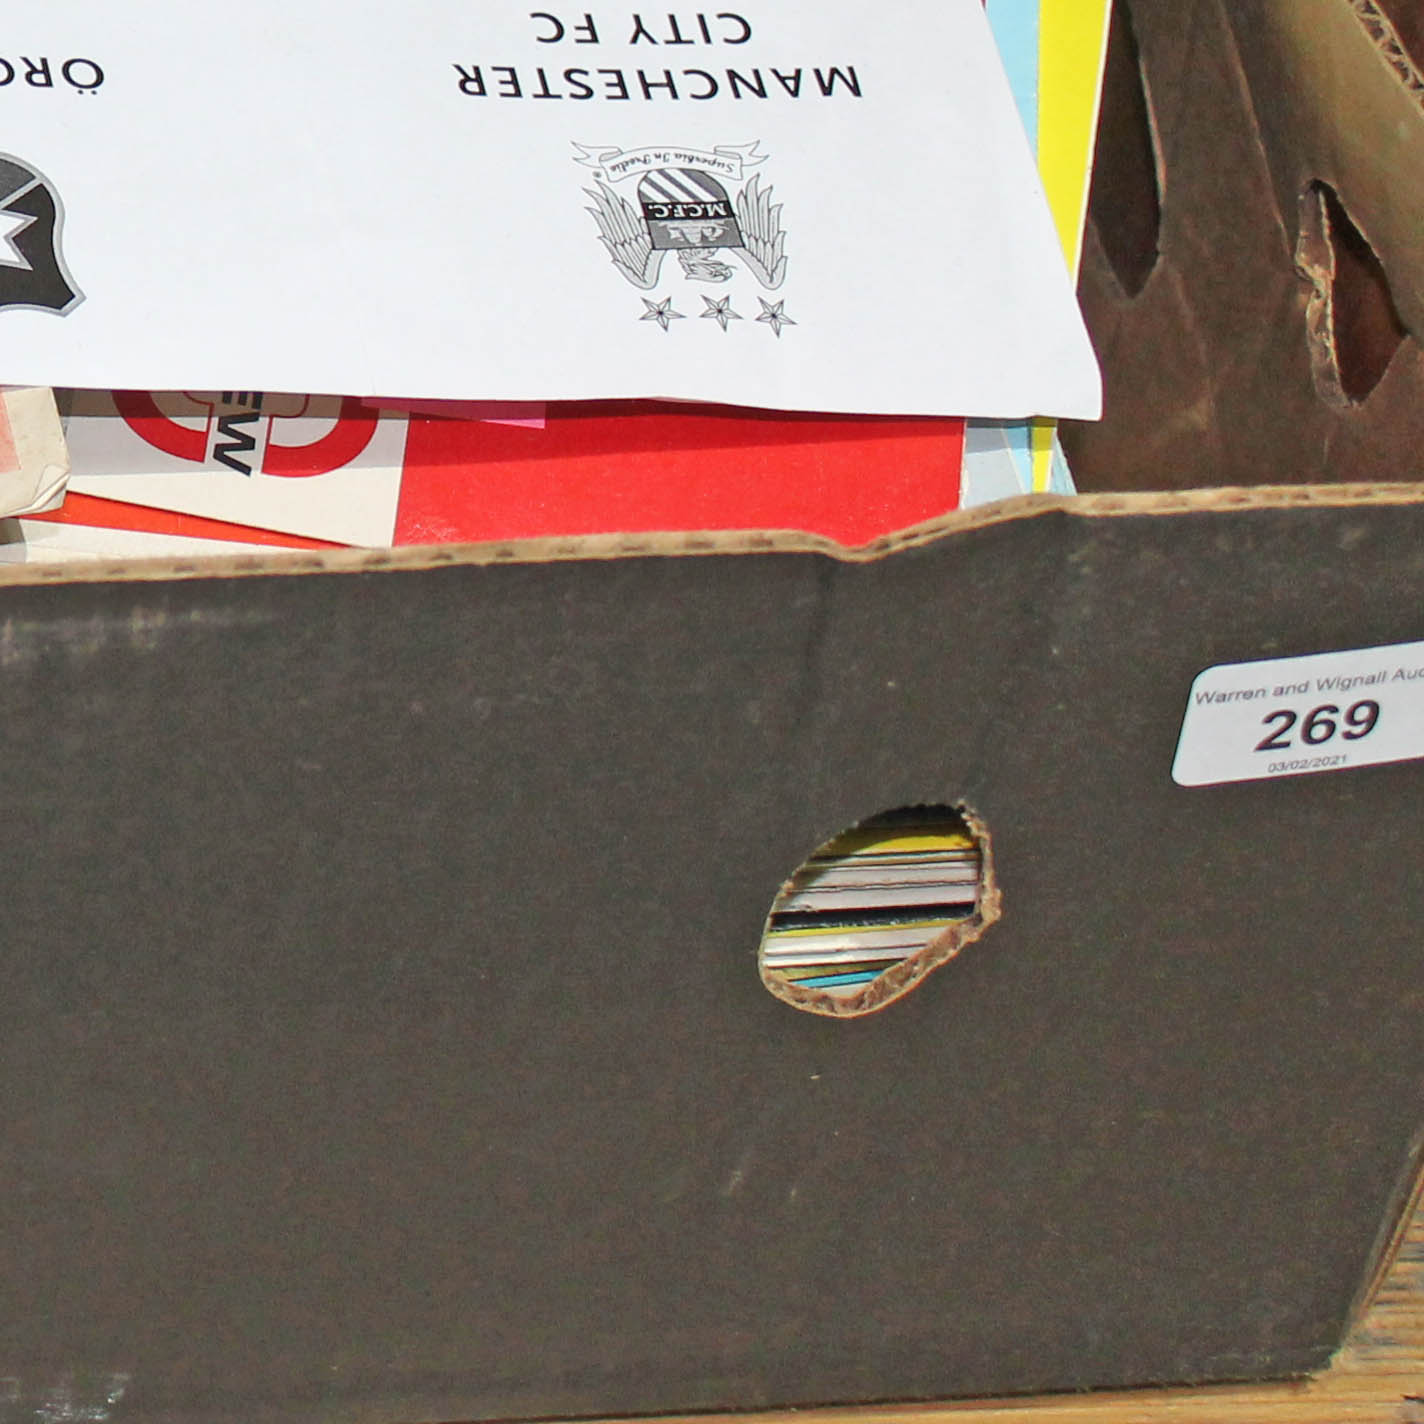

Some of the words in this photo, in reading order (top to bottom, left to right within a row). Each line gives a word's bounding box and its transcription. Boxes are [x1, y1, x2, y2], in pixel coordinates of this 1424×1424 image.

[529, 12, 600, 45] FC
[629, 12, 752, 45] CITY
[452, 64, 863, 100] MANCHESTER
[647, 203, 728, 219] M.C.F.C.
[1195, 687, 1267, 706] Warren
[1272, 680, 1310, 697] and
[1316, 669, 1388, 692] Wignall
[1253, 699, 1380, 752] 269
[1268, 754, 1347, 774] 03/02/2021
